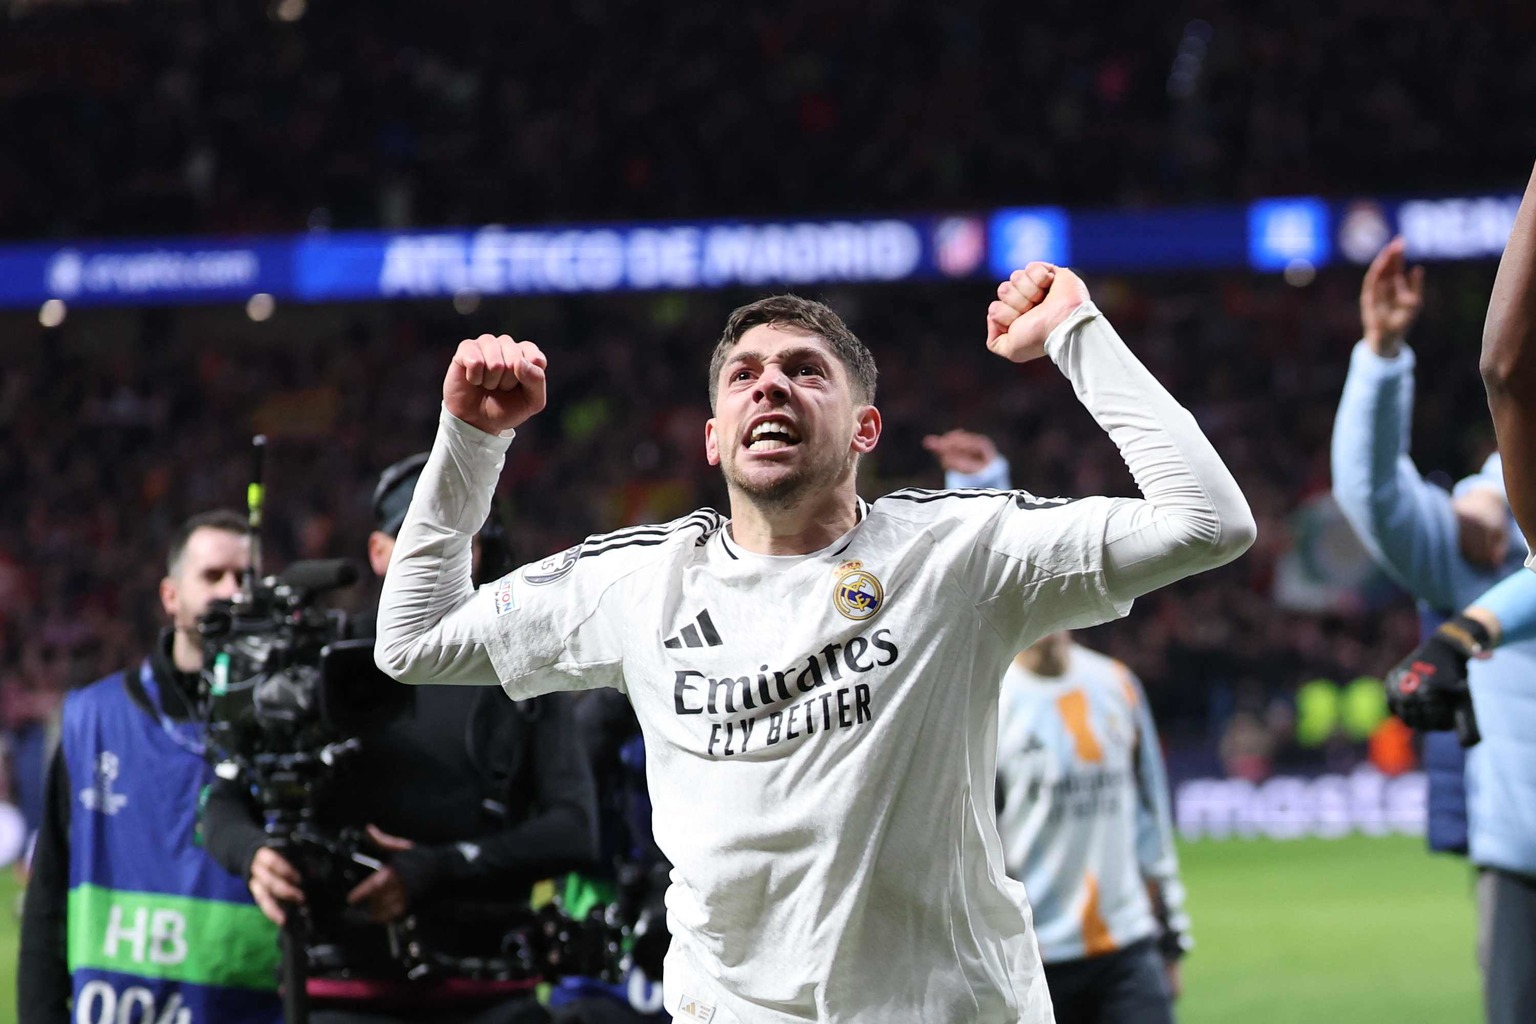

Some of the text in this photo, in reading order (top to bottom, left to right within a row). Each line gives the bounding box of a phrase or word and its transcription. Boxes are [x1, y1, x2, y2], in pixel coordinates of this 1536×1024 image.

[674, 628, 899, 715] Emirates
[708, 683, 872, 756] FLY BETTER
[103, 904, 188, 965] HB
